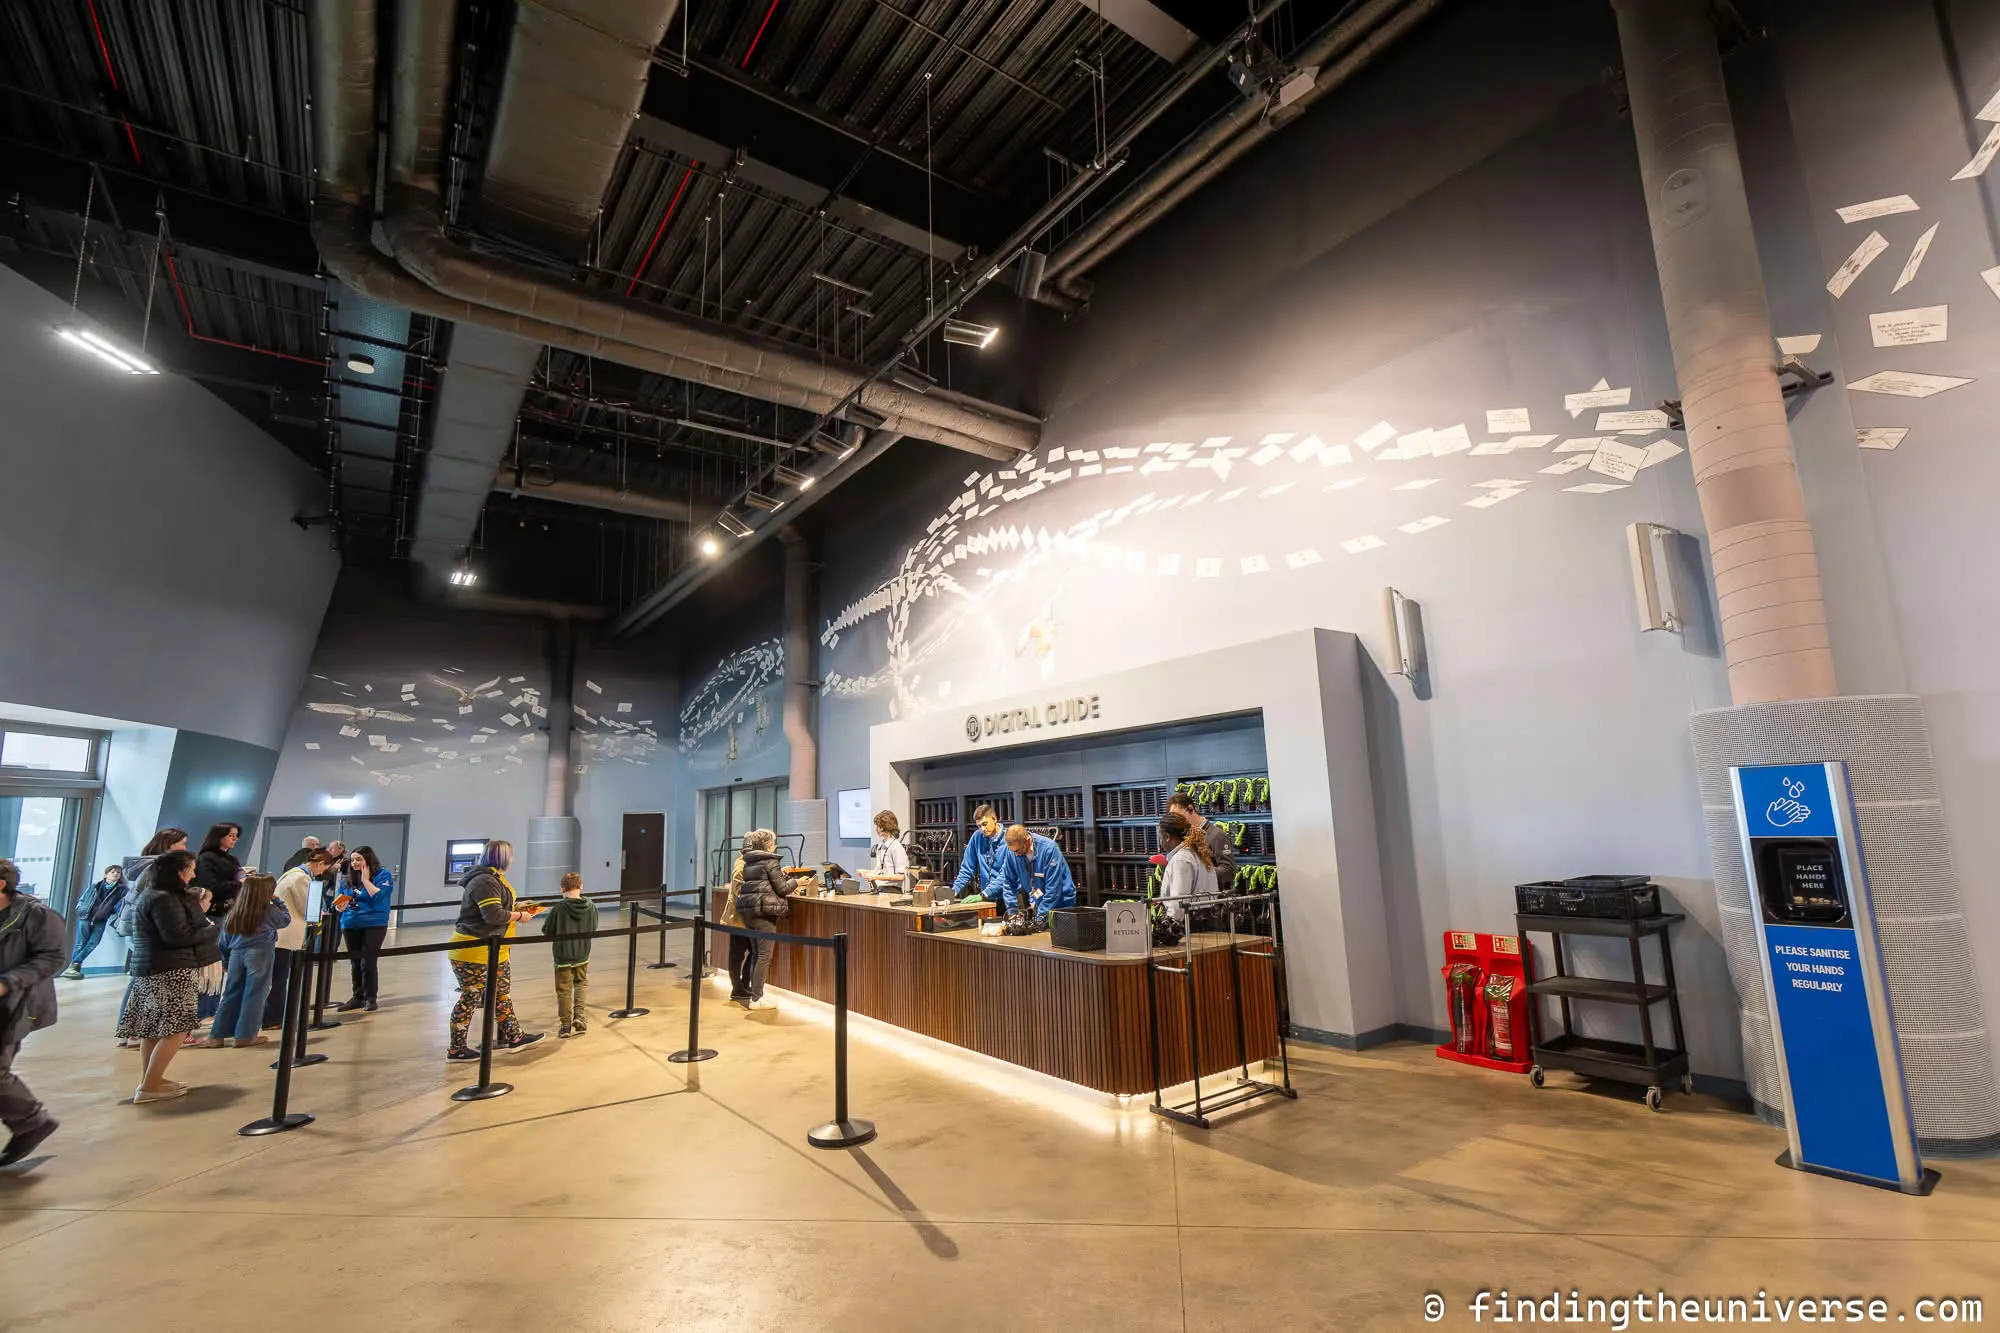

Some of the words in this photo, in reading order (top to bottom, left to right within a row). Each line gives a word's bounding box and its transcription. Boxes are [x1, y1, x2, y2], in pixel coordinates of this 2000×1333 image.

[983, 705, 1042, 737] DIGITAL
[1047, 694, 1100, 727] GUIDE
[1775, 945, 1809, 957] PLEASE
[1809, 947, 1851, 960] SANITISE
[1786, 962, 1811, 974] YOUR
[1811, 964, 1845, 976] HANDS
[1792, 979, 1843, 993] REGULARLY
